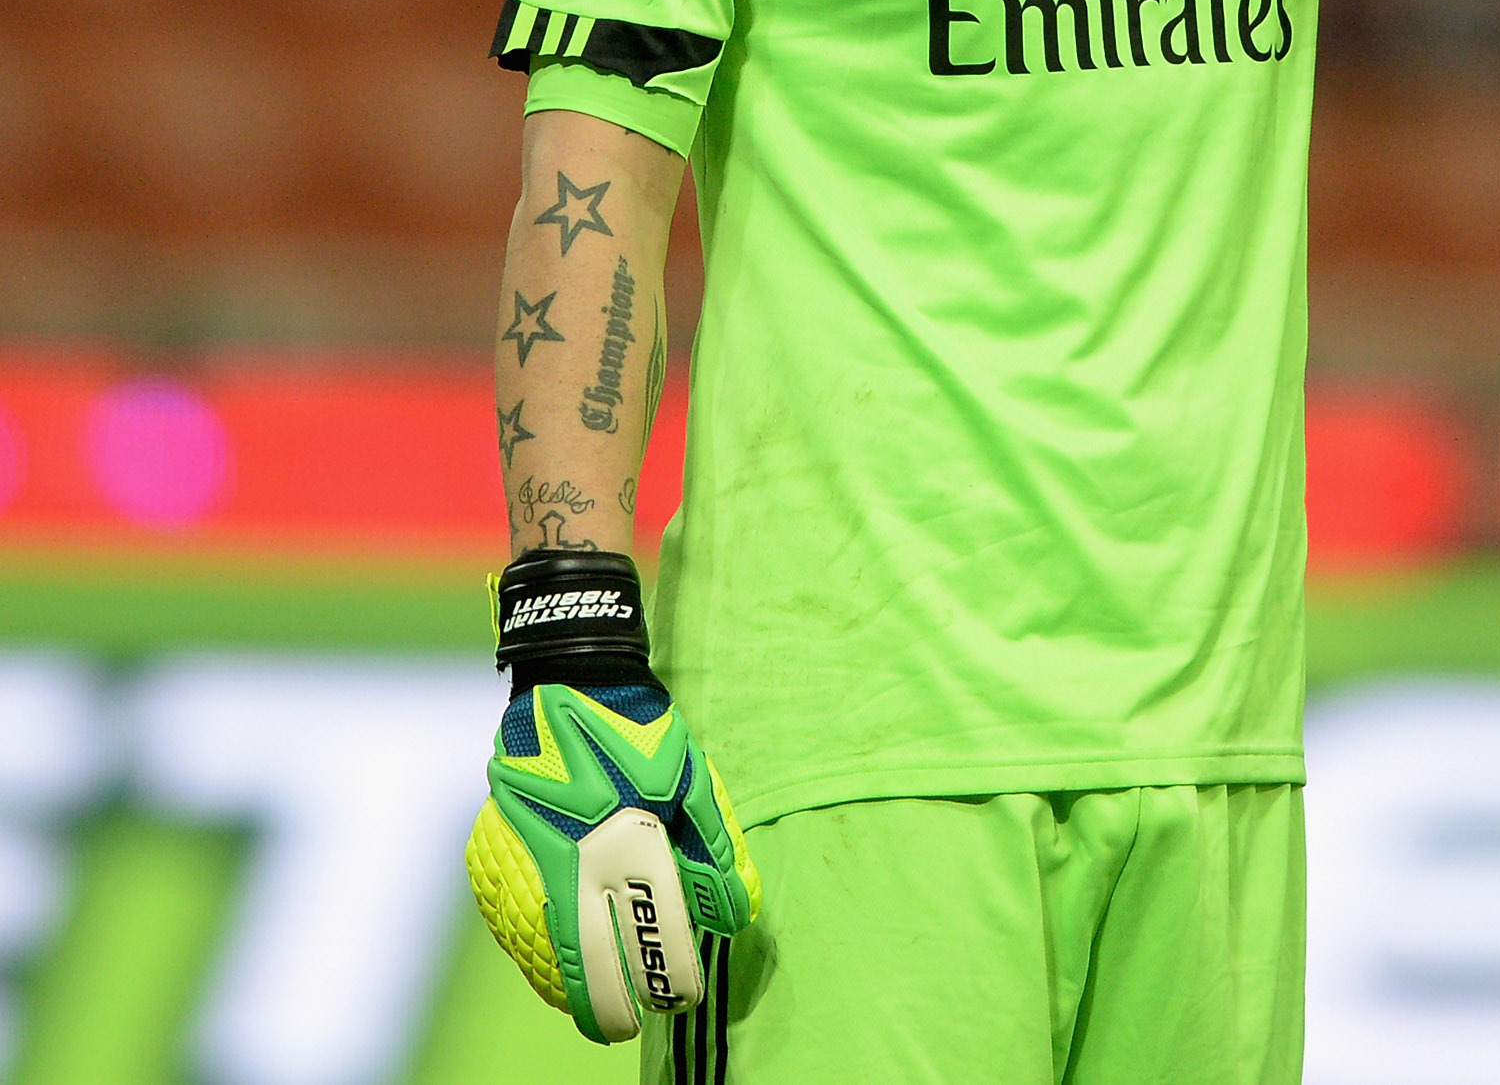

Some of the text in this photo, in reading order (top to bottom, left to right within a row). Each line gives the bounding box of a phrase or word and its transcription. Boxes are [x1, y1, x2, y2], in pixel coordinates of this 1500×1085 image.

[512, 590, 621, 615] ABBIATI
[503, 603, 633, 633] CHRISTIAN
[626, 881, 683, 1010] reusch
